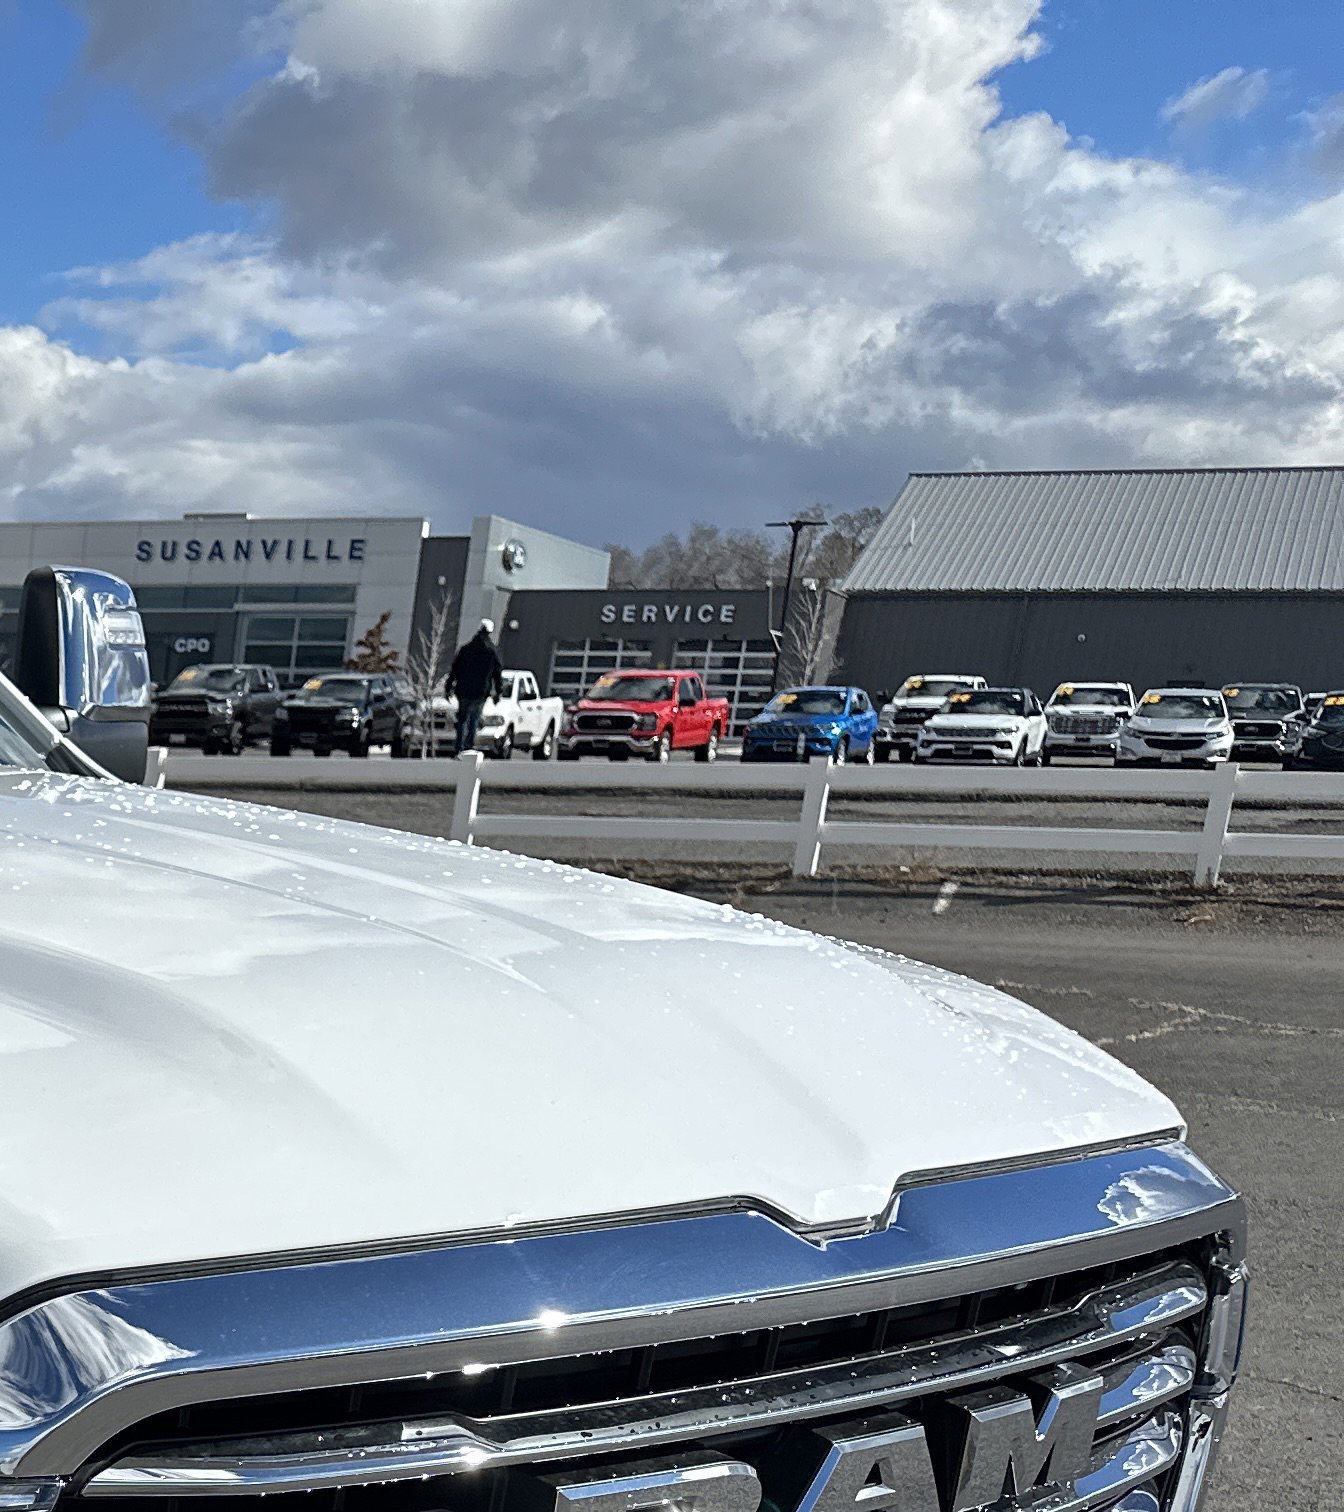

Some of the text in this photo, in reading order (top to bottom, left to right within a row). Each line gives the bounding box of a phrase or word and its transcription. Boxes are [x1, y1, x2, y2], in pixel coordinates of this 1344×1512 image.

[135, 539, 367, 562] SUSANVILLE
[600, 604, 737, 623] SERVICE
[174, 638, 210, 653] CPO
